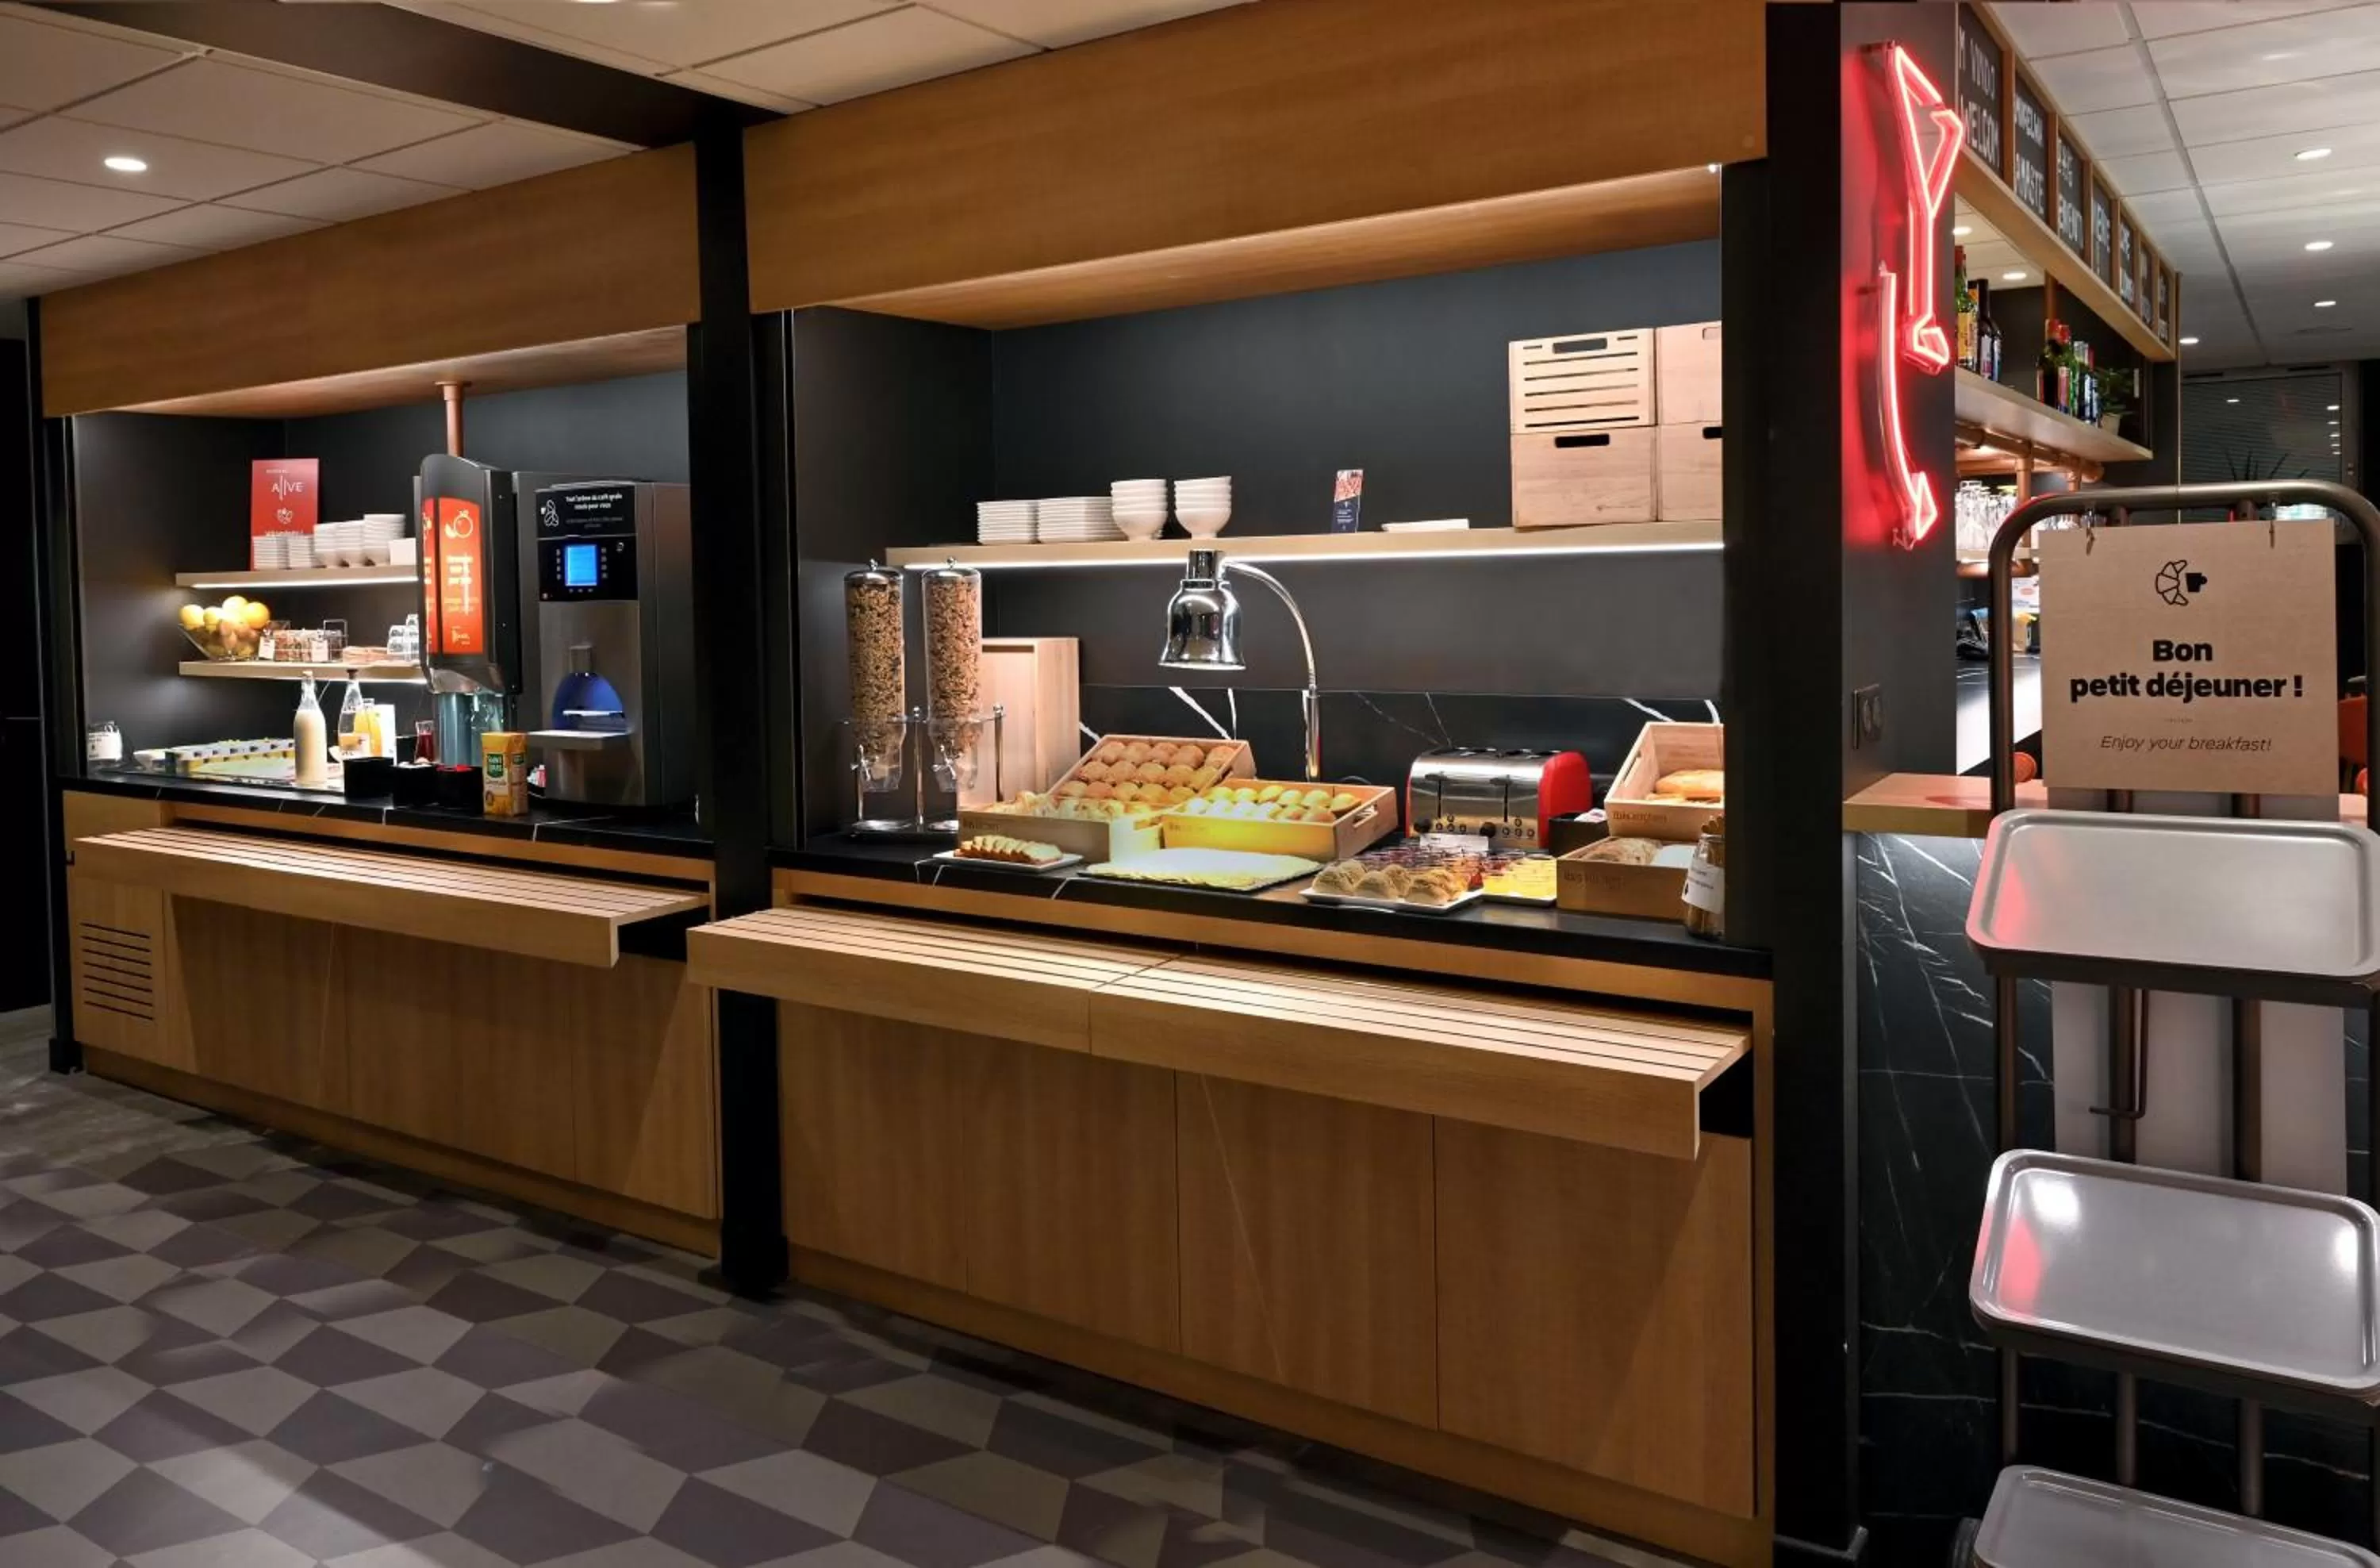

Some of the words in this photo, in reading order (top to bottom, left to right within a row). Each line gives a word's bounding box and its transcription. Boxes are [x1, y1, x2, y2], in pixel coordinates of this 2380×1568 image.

[2152, 639, 2213, 663] Bon
[2070, 672, 2140, 704] petit
[2100, 736, 2145, 753] Enjoy
[2148, 737, 2186, 752] your
[2187, 736, 2272, 752] breakfast!
